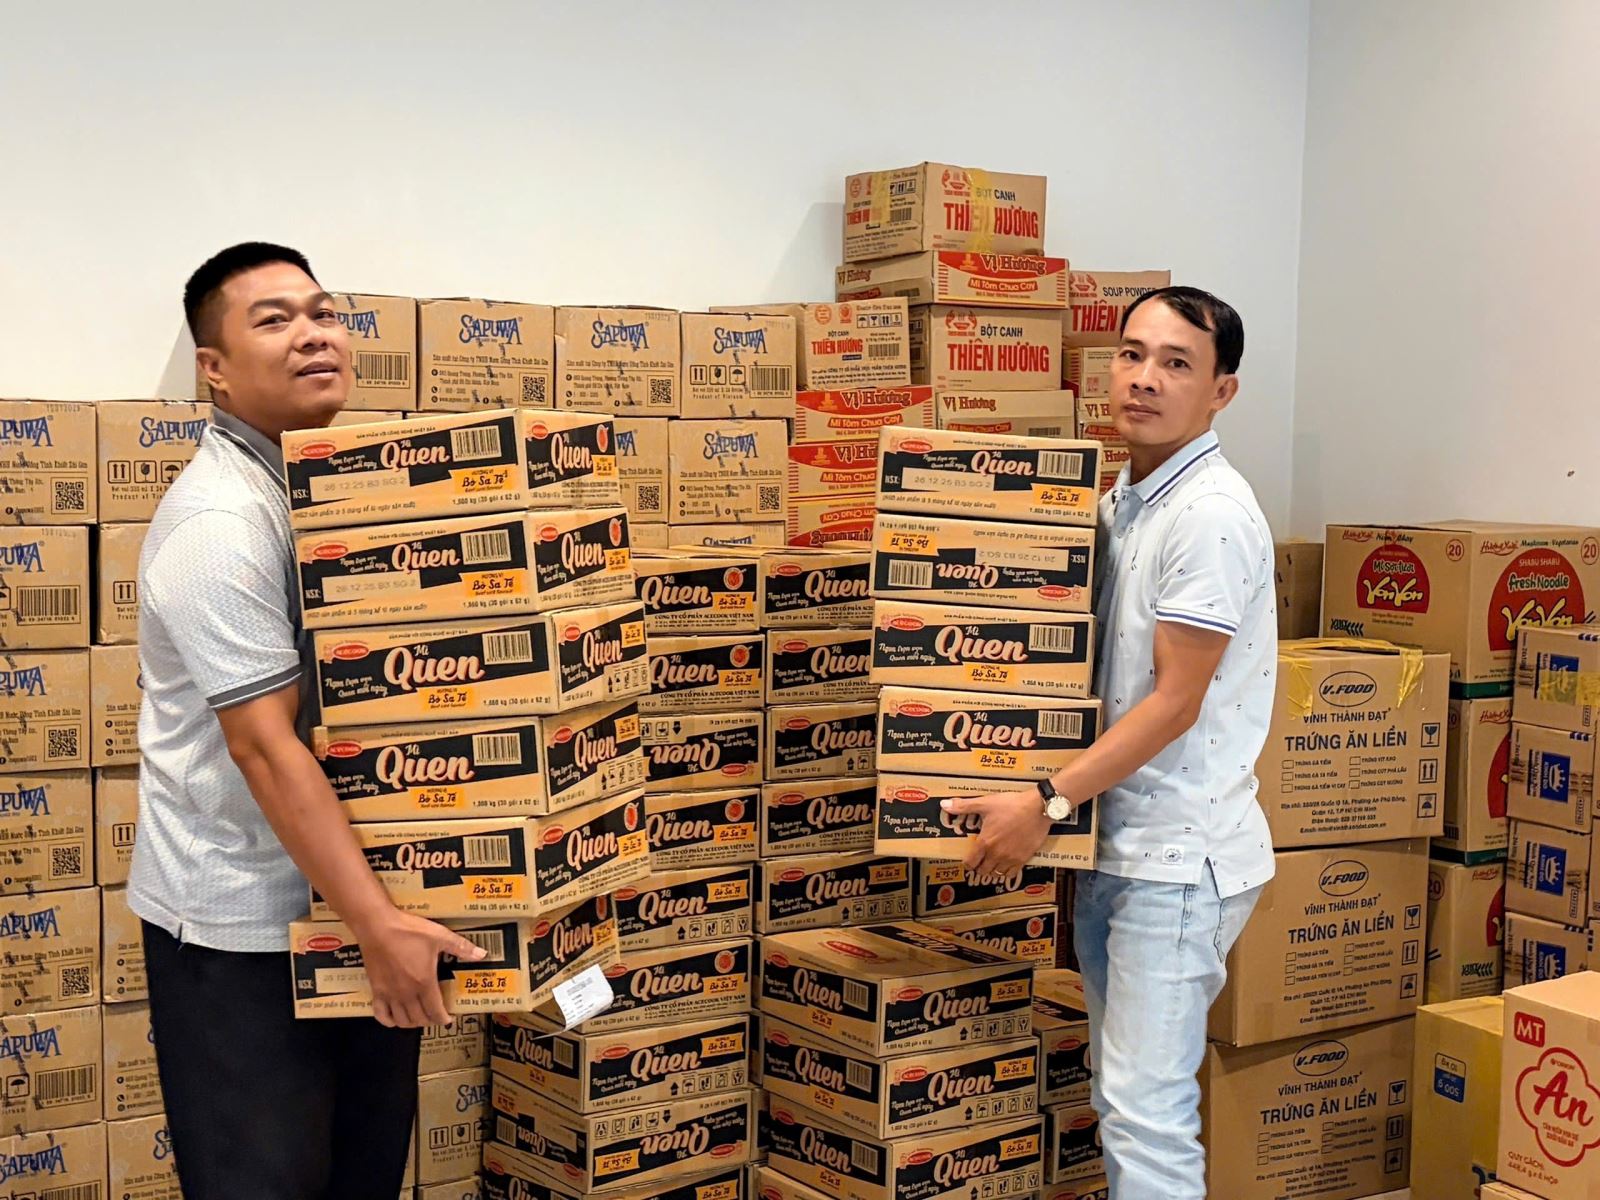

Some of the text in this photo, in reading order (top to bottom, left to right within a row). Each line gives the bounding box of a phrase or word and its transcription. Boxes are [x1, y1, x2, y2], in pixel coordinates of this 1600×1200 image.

[994, 189, 1016, 201] CANH
[994, 205, 1038, 239] HƯƠNG
[981, 255, 1045, 273] Vị Hương
[982, 281, 997, 289] Tôm
[999, 283, 1018, 291] Chua
[1021, 282, 1035, 290] Cay
[1103, 287, 1123, 296] SOUP
[459, 314, 523, 345] SAPUWA
[1069, 299, 1118, 331] THIÊN
[591, 320, 650, 349] SAPUWA
[713, 327, 768, 354] SAPUWA
[812, 338, 863, 354] THIÊN HƯƠNG
[981, 326, 1023, 338] BỘT CANH
[948, 339, 1050, 372] THIÊN HƯƠNG
[841, 390, 911, 409] Vị Hương
[943, 396, 996, 412] Vị Hương
[830, 415, 900, 427] Mì Tôm Chua Cay
[380, 439, 450, 471] Quen
[550, 432, 593, 470] Quen
[703, 433, 759, 460] SAPUWA
[834, 445, 852, 464] Vị
[462, 470, 508, 487] Bò Sa Tế
[823, 473, 875, 481] Mì Tôm Chua
[971, 451, 1035, 477] Quen
[392, 543, 461, 575] Quen
[561, 531, 605, 575] Quen
[1448, 544, 1461, 556] 20
[1540, 558, 1560, 566] SHABU
[1583, 544, 1596, 558] 20
[472, 576, 515, 591] Bò Sa Tế
[804, 570, 870, 600] Quen
[936, 562, 999, 588] Quen
[1537, 573, 1569, 590] Noodle
[641, 576, 712, 610] Quen
[582, 630, 623, 674] Quen
[934, 625, 1029, 663] Quen
[384, 646, 486, 692] Quen
[651, 656, 718, 689] Quen
[810, 647, 870, 675] Quen
[1322, 684, 1374, 695] V.FOOD
[943, 711, 1036, 749] Quen
[1330, 710, 1365, 722] THÀNH
[1368, 710, 1387, 722] ĐẠT
[573, 730, 618, 772] Quen
[811, 722, 875, 754] Quen
[1284, 731, 1341, 751] TRỨNG
[1346, 730, 1368, 749] ĂN
[376, 746, 476, 791] Quen
[650, 738, 720, 771] Quen
[806, 797, 872, 829] Quen
[647, 814, 713, 847] Quen
[396, 843, 462, 873] Quen
[566, 830, 618, 871] Quen
[805, 873, 870, 905] Quen
[1321, 871, 1367, 886] V.FOOD
[638, 891, 708, 924] Quen
[1304, 897, 1378, 915] VĨNH THÀNH ĐẠT
[0, 907, 61, 940] APUWA
[1288, 923, 1337, 944] TRỨNG
[1341, 919, 1360, 936] ĂN
[552, 922, 595, 963] Quen
[629, 967, 703, 999] Quen
[792, 968, 843, 1011] Quen
[923, 992, 990, 1026] Quen
[1516, 1017, 1544, 1042] MT
[514, 1028, 553, 1070] Quen
[1296, 1051, 1346, 1066] V.FOOD
[630, 1049, 701, 1082] Quen
[794, 1047, 846, 1092] Quen
[927, 1071, 995, 1105] Quen
[1278, 1075, 1360, 1096] VĨNH THÀNH ĐẠT
[1533, 1071, 1594, 1126] An
[1260, 1088, 1377, 1125] TRỨNG ĂN LIỀN
[517, 1126, 547, 1156] Quen
[639, 1123, 710, 1155] Quen
[800, 1126, 851, 1172] Quen
[933, 1153, 999, 1188] Quen
